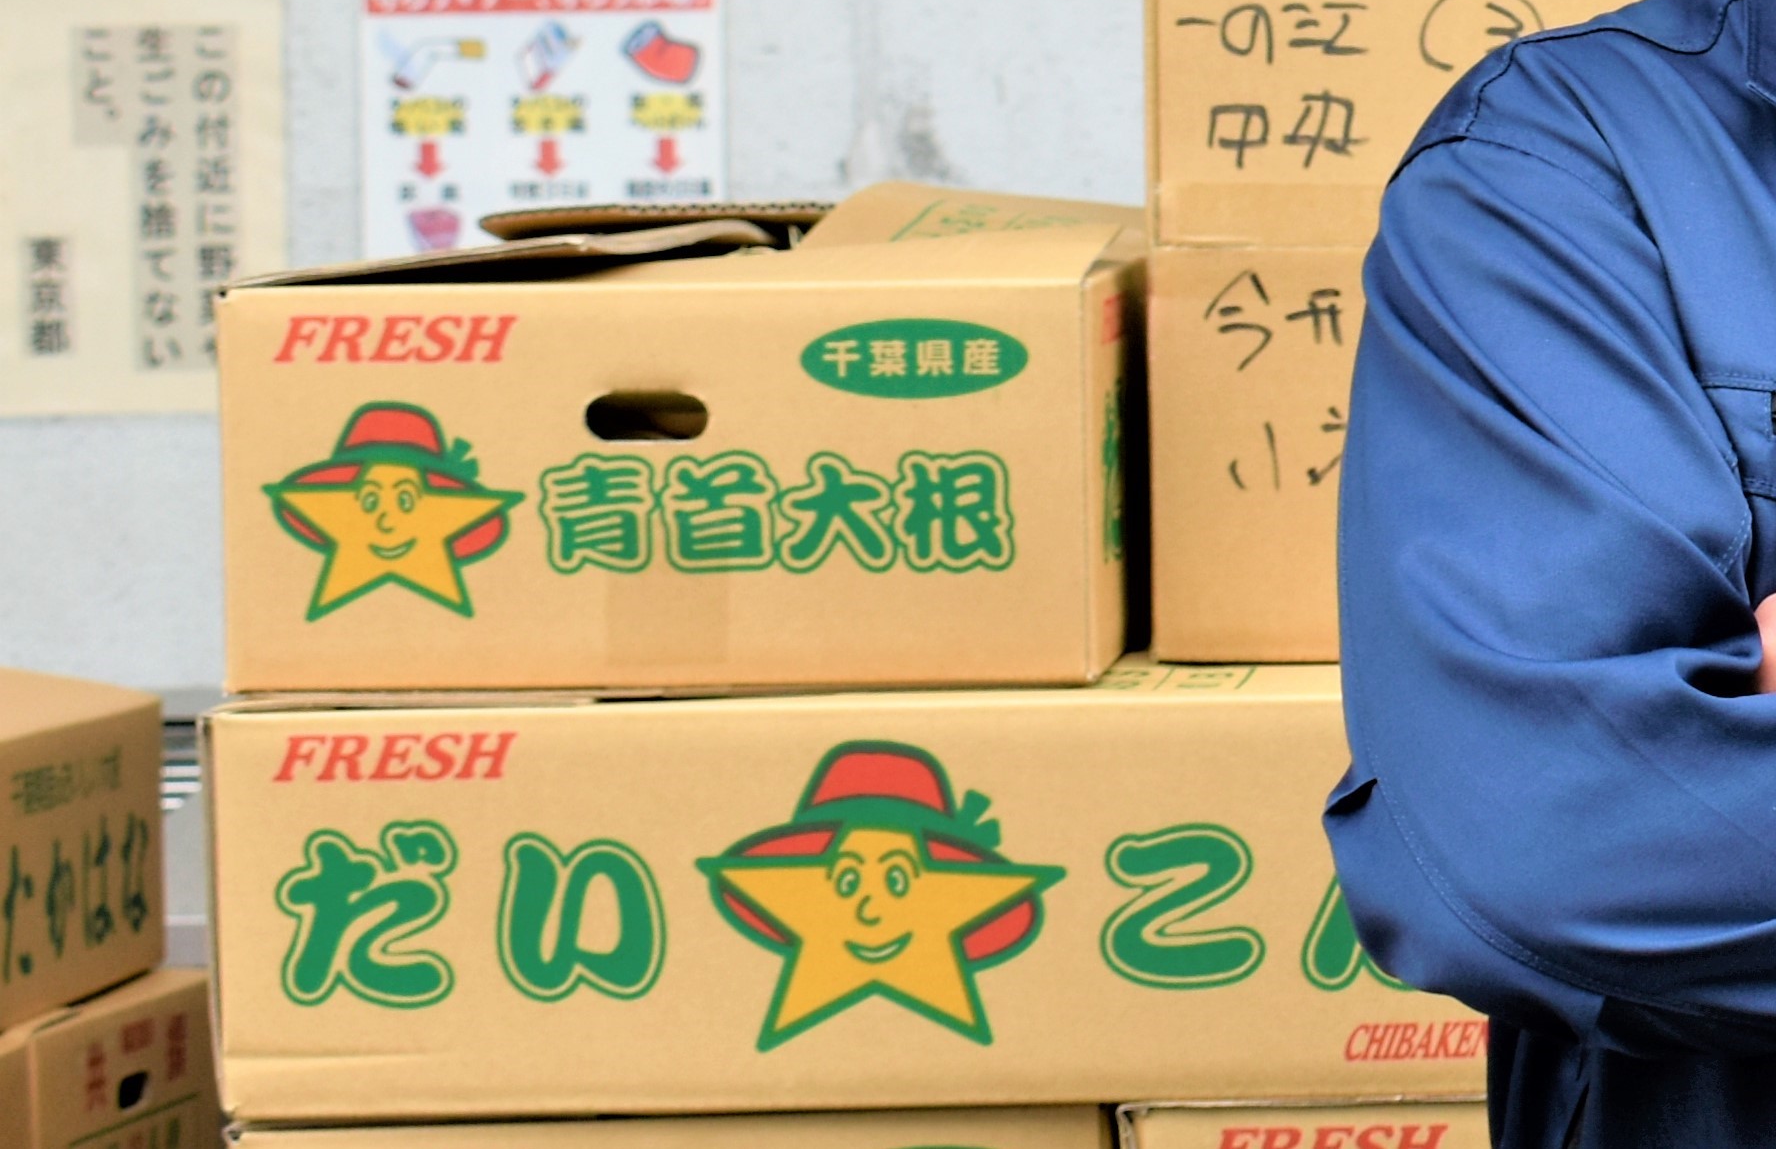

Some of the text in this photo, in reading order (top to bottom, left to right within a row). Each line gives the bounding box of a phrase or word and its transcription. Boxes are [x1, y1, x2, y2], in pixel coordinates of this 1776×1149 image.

[29, 237, 69, 355] 東京都
[274, 314, 516, 363] FRESH
[822, 338, 1002, 377] 千葉県産
[540, 451, 1014, 574] 青首大根
[273, 731, 516, 783] FRESH
